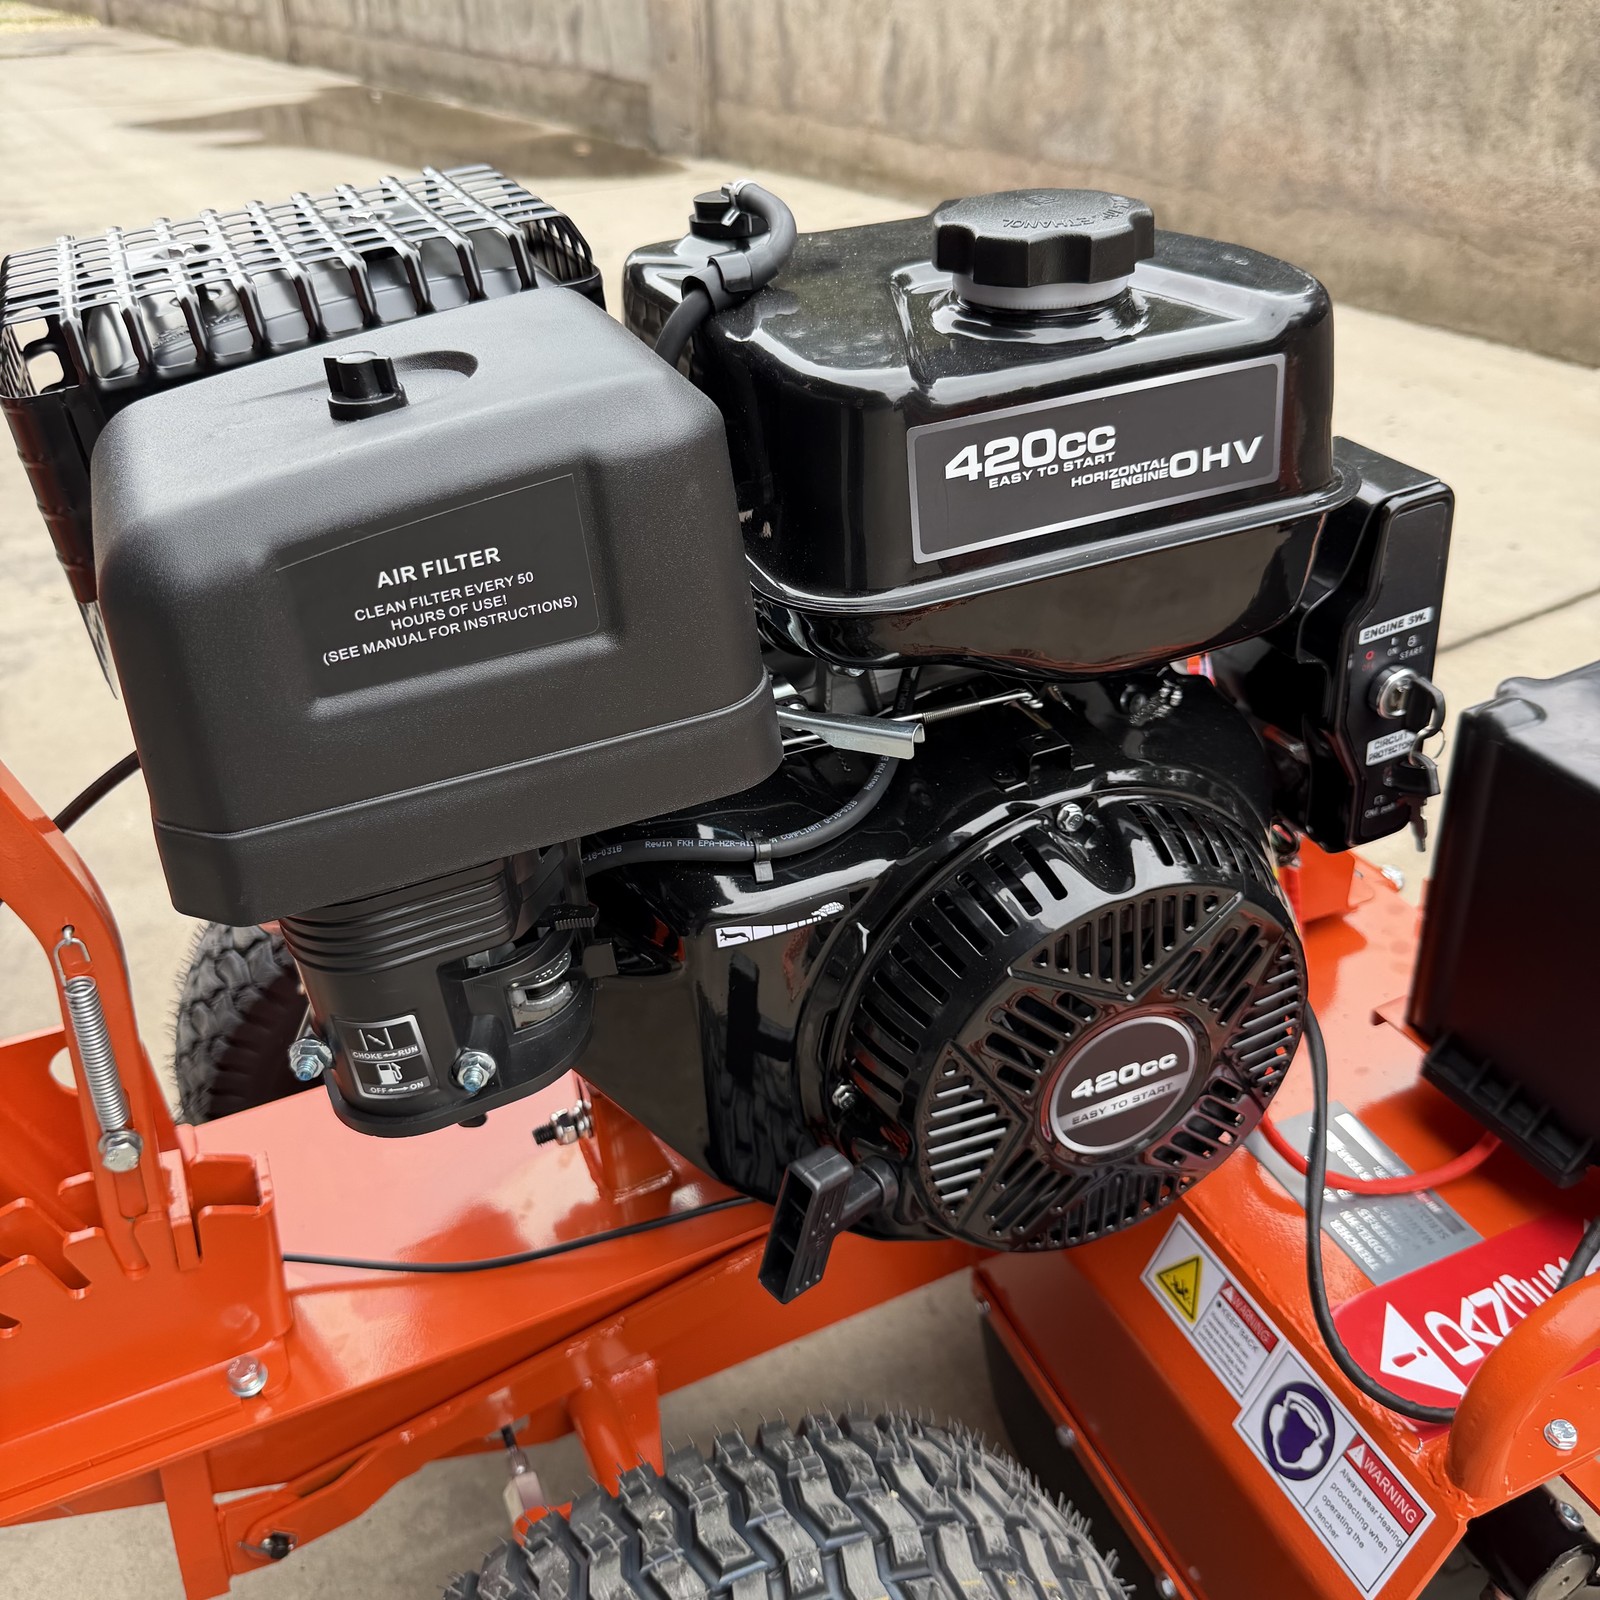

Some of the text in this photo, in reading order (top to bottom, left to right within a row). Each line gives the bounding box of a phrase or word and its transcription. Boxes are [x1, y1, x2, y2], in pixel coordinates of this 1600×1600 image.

[944, 425, 1117, 483] 420cc
[988, 451, 1116, 489] EASY TO START
[1070, 458, 1169, 488] HORIZONTAL
[1168, 435, 1264, 479] OHV
[1110, 470, 1169, 491] ENGINE
[377, 546, 501, 589] AIR FILTER
[354, 570, 534, 622] CLEAN FILTER EVERY 50
[390, 593, 508, 631] HOURS OF USE!
[322, 594, 579, 666] (SEE MANUAL FOR INSTRUCTIONS)
[1363, 618, 1405, 641] ENGINE
[645, 839, 673, 849] Rewin
[780, 822, 822, 841] COMPLIANT
[582, 844, 622, 862] -18-031B
[352, 1045, 419, 1060] CHOKE RUN
[370, 1080, 424, 1094] OFF ON
[1071, 1053, 1178, 1099] 420cc
[1071, 1082, 1175, 1125] EASY TO START
[1232, 1298, 1271, 1341] WARNING
[1340, 1467, 1404, 1548] Always wear Hearing
[1363, 1456, 1417, 1524] WARNING
[1312, 1505, 1340, 1540] trencher
[1321, 1494, 1365, 1549] operating the
[1368, 1527, 1388, 1554] when
